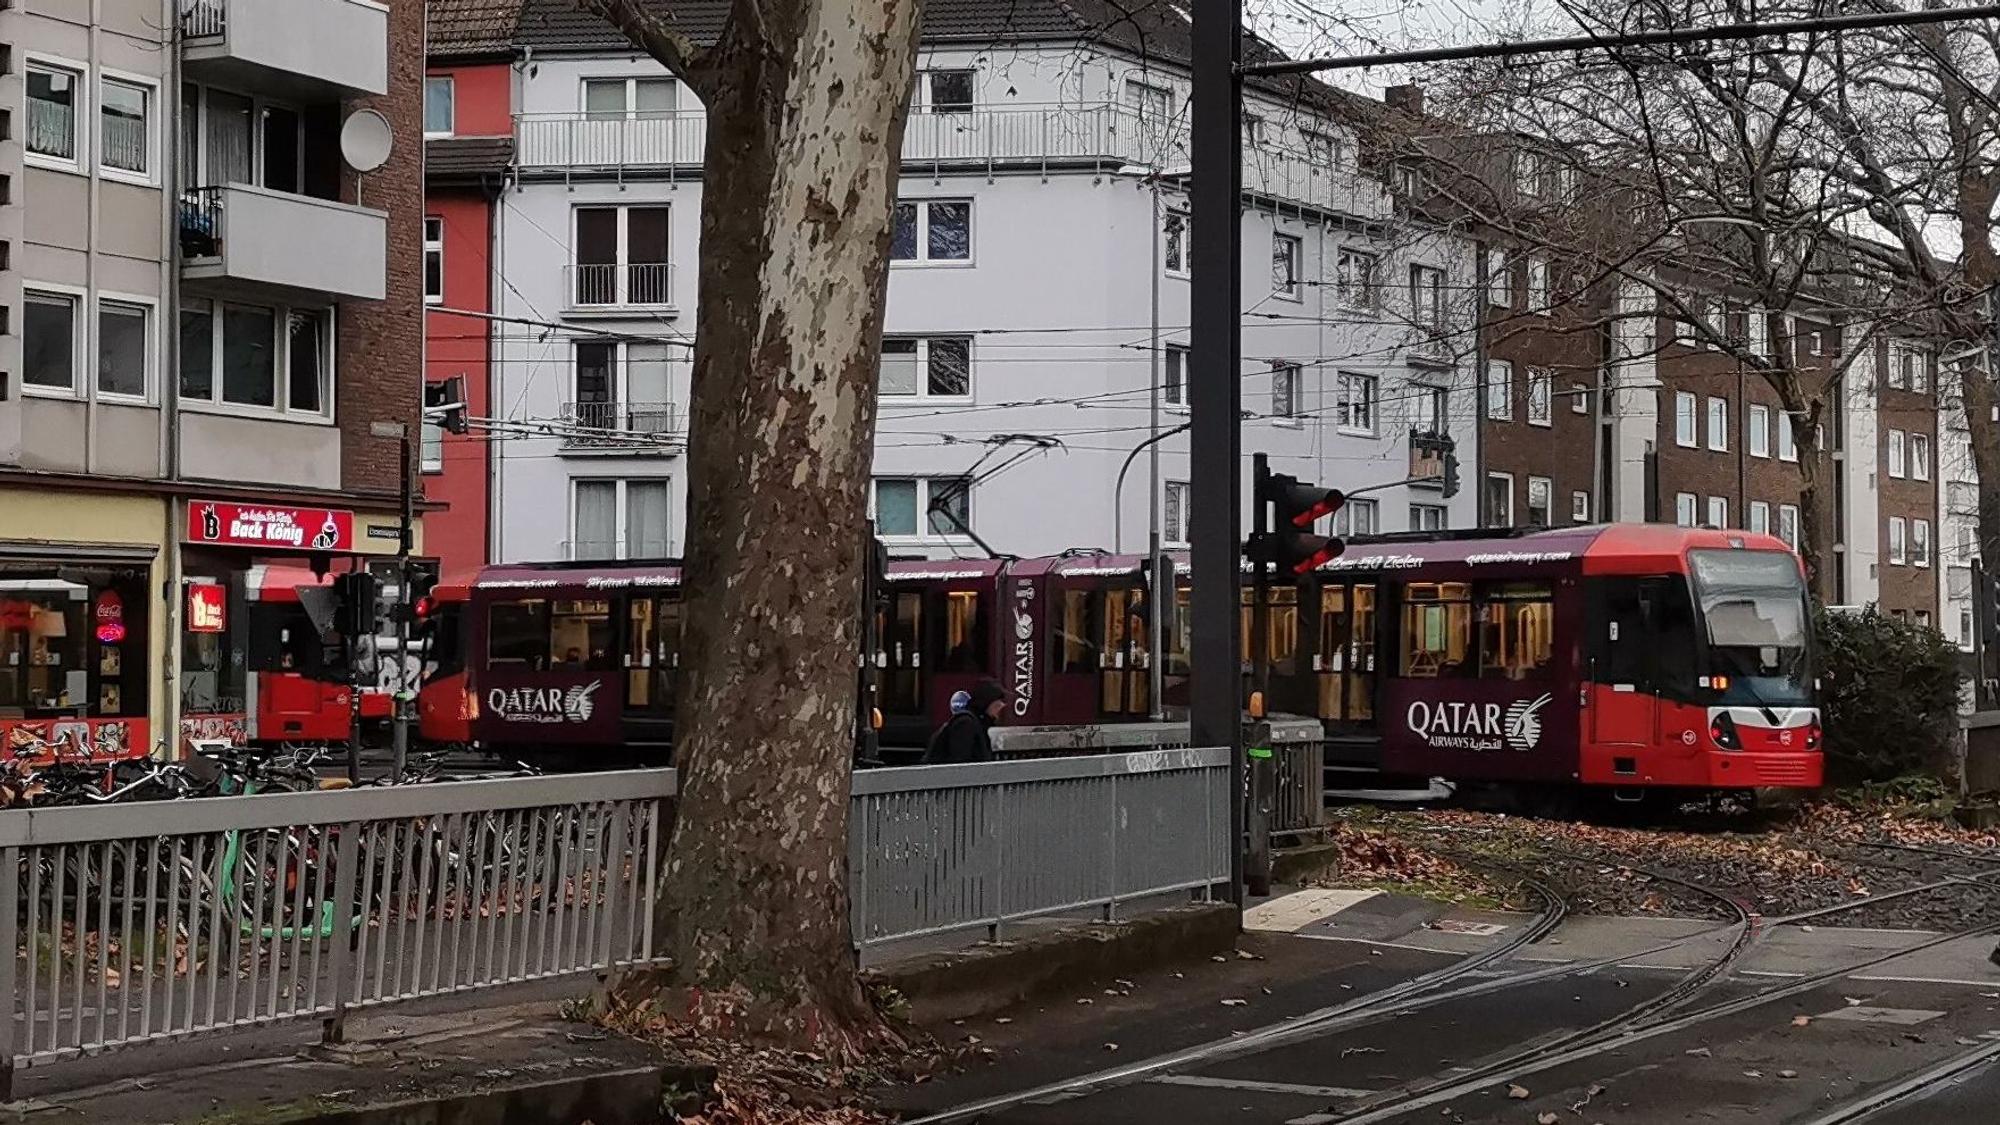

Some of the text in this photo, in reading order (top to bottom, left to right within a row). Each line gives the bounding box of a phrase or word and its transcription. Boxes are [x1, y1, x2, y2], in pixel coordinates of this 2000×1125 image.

[230, 519, 304, 546] Back König
[1383, 553, 1425, 570] Zielen
[1014, 642, 1031, 716] QATAR
[488, 687, 563, 718] QATAR
[1407, 700, 1502, 740] QATAR
[1428, 736, 1469, 748] AIRWAYS
